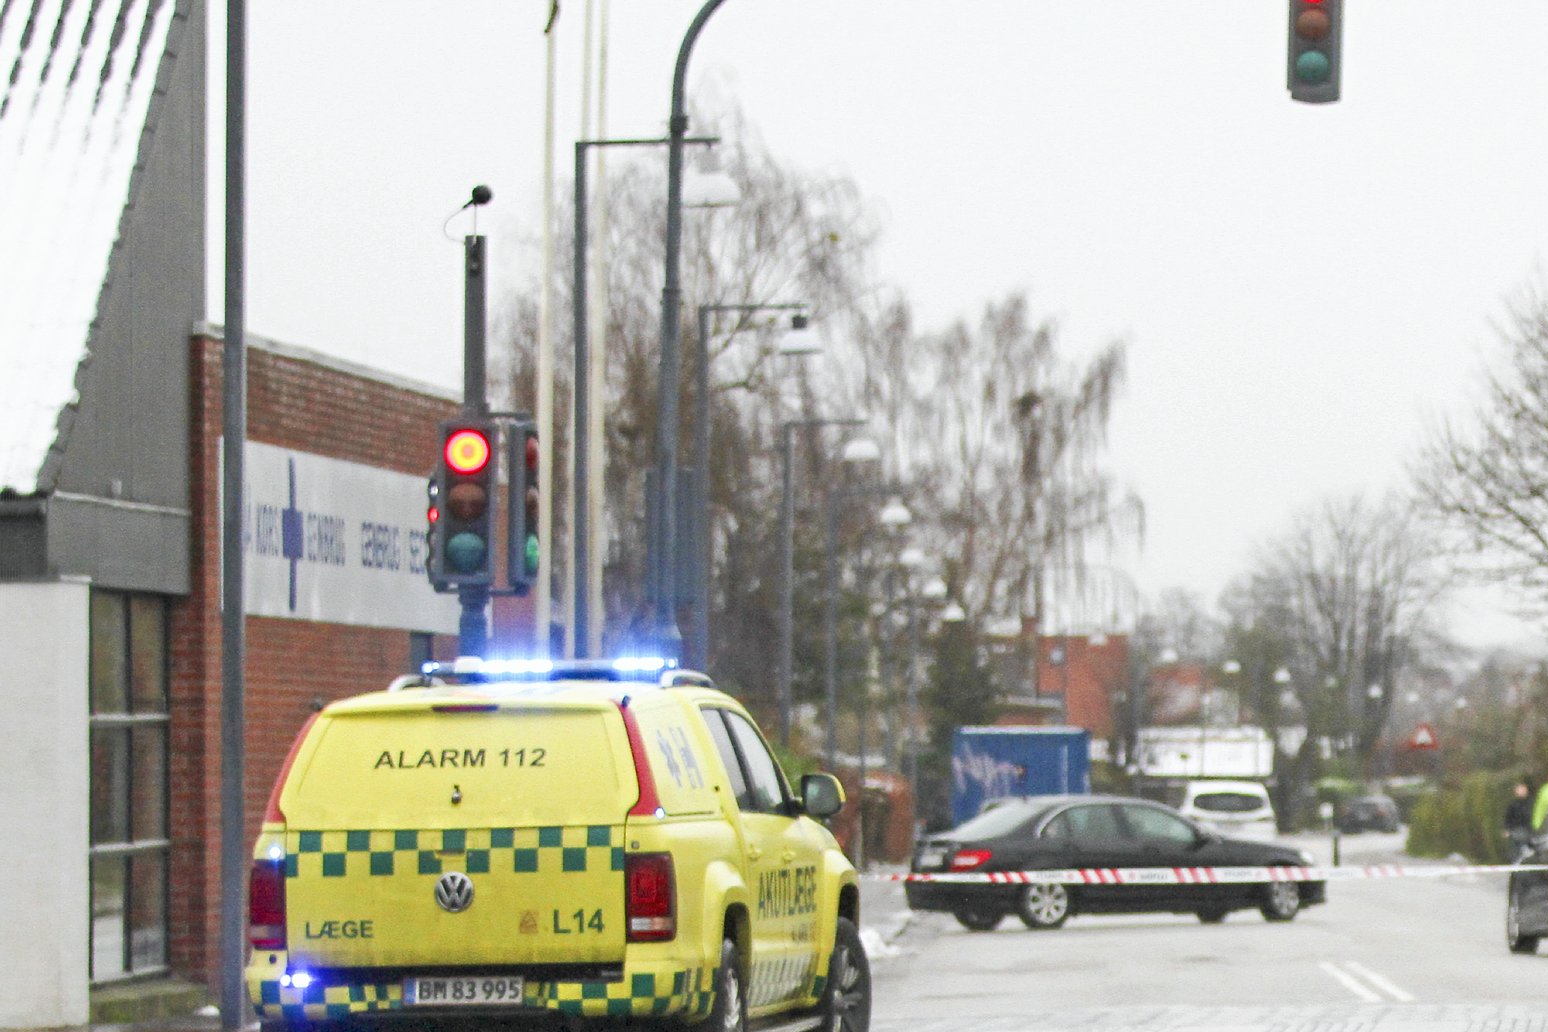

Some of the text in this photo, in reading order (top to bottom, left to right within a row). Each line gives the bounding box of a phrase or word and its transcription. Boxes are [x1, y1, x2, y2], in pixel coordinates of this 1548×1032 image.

[374, 747, 546, 770] ALARM 112
[757, 865, 817, 921] AKUTLÆGE
[305, 920, 374, 939] LÆGE
[553, 908, 605, 934] L14
[418, 978, 522, 1000] BM 83 995
